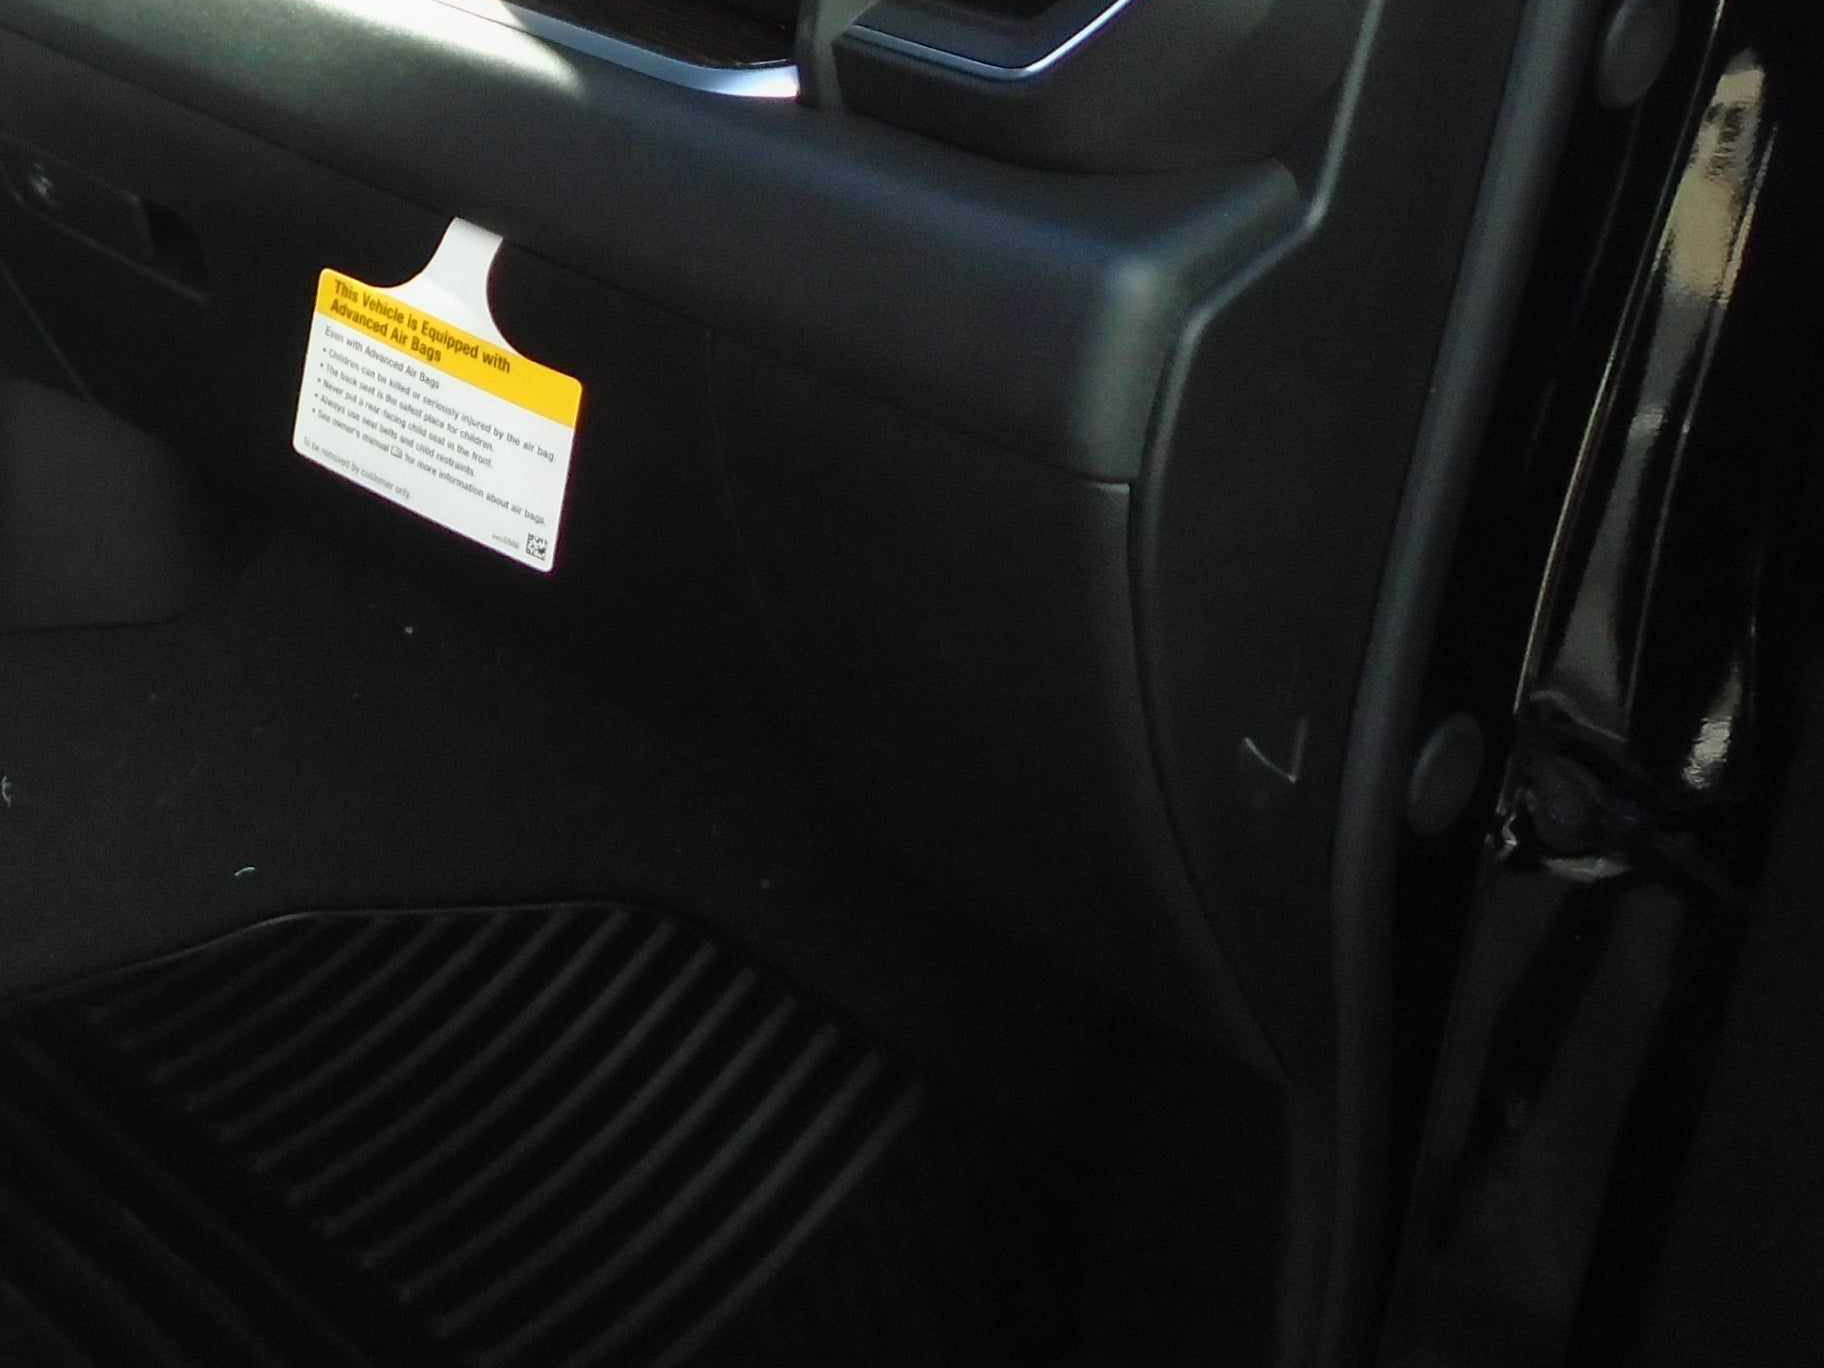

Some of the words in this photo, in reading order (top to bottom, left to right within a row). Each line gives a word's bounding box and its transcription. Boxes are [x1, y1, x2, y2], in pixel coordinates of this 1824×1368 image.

[325, 326, 344, 343] Even
[346, 337, 363, 352] with
[364, 346, 404, 372] Advanced
[405, 365, 417, 378] Air
[419, 372, 439, 389] Bags
[330, 299, 388, 337] Advanced
[390, 327, 408, 346] Air
[411, 335, 441, 362] Bags
[335, 279, 358, 303] This
[362, 292, 404, 324] Vehicle
[407, 313, 417, 331] is
[421, 320, 479, 358] Equipped
[482, 350, 511, 373] with
[320, 394, 345, 414] Always
[347, 410, 360, 421] use
[362, 416, 378, 430] seat
[379, 424, 397, 440] belts
[399, 435, 414, 448] and
[415, 443, 435, 458] child
[323, 379, 344, 395] Never
[344, 392, 358, 403] put
[358, 398, 364, 407] a
[407, 421, 427, 437] child
[428, 432, 446, 446] seat
[447, 440, 455, 450] in
[457, 444, 470, 458] the
[326, 363, 339, 377] The
[340, 371, 357, 387] back
[359, 382, 375, 395] seat
[377, 390, 384, 399] is
[385, 394, 398, 406] the
[399, 401, 422, 417] safest
[423, 413, 445, 429] place
[446, 423, 458, 434] for
[460, 430, 494, 452] children.
[328, 348, 359, 371] Children
[361, 366, 375, 378] can
[377, 373, 387, 384] be
[389, 379, 411, 395] killed
[412, 391, 420, 400] or
[423, 396, 459, 420] seriously
[461, 413, 491, 433] injured
[493, 427, 504, 440] by
[506, 432, 520, 446] the
[523, 441, 535, 452] air
[304, 436, 311, 447] To
[311, 441, 320, 452] be
[321, 448, 350, 469] removed
[351, 462, 360, 474] by
[360, 468, 394, 490] customer
[318, 409, 331, 423] See
[361, 433, 390, 453] manual
[404, 453, 415, 464] for
[417, 460, 437, 476] more
[439, 471, 484, 497] information
[486, 492, 510, 510] about
[510, 505, 522, 515] air
